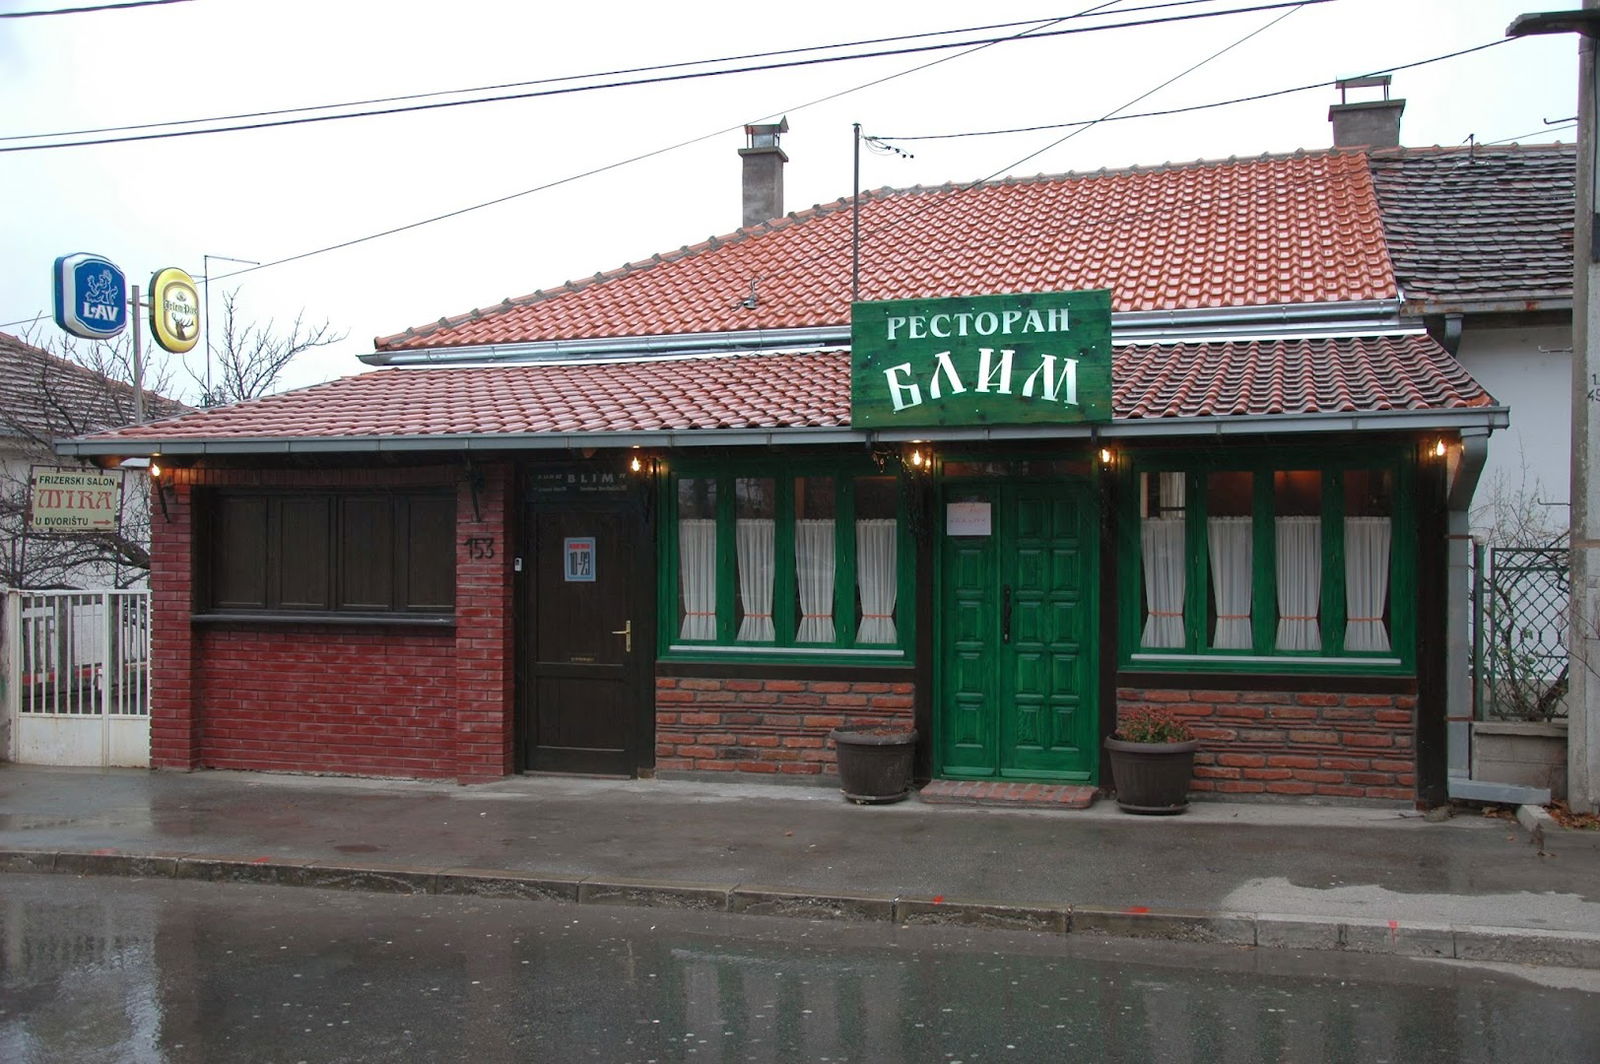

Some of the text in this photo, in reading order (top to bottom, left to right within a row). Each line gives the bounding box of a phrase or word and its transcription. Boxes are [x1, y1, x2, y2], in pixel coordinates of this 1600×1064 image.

[83, 301, 119, 322] LAV
[886, 308, 1071, 340] РЕСТОРАН
[882, 347, 1080, 412] БЛИМ
[39, 475, 115, 487] FRIZERSKI SALON
[38, 490, 112, 509] MIRA
[35, 515, 89, 526] U DVORIŠTU
[463, 537, 494, 560] 153
